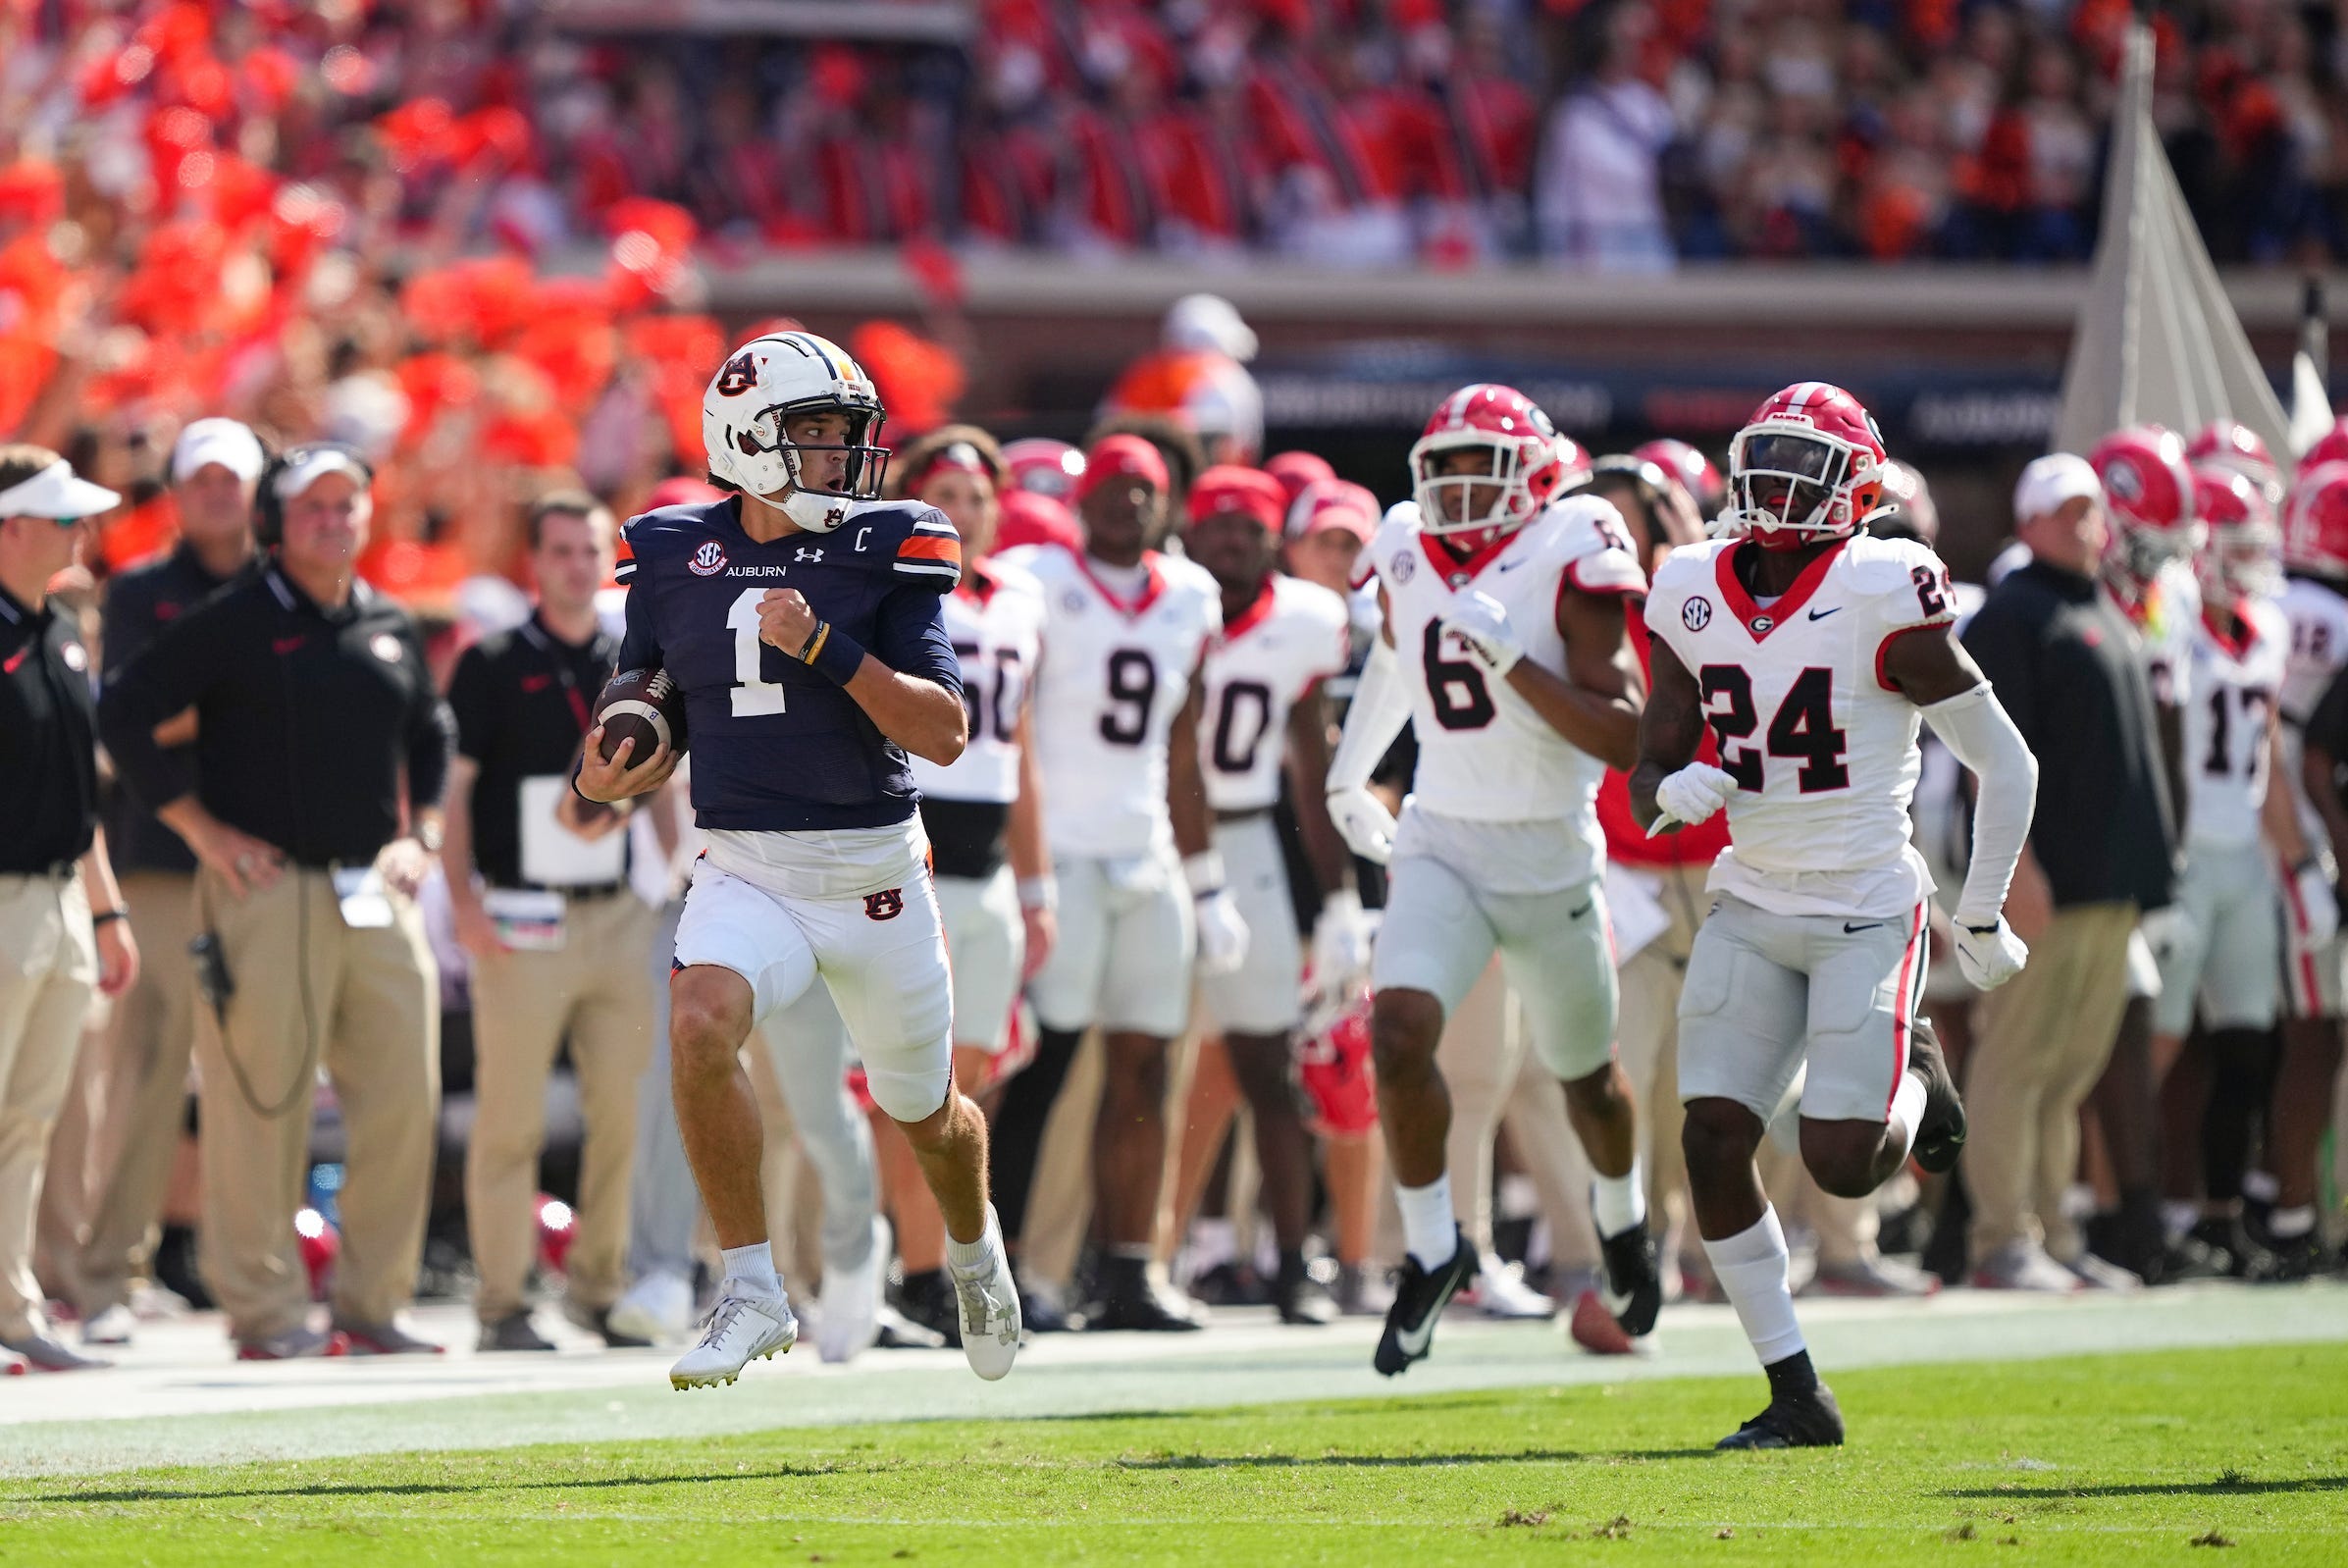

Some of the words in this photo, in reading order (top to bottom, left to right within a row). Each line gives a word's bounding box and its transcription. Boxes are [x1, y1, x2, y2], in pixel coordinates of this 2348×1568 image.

[855, 527, 872, 552] C
[697, 542, 721, 567] SEC
[725, 566, 786, 577] AUBURN
[1684, 600, 1711, 629] SEC
[1753, 617, 1772, 632] G
[725, 587, 786, 717] 1
[1424, 616, 1496, 731] 6
[1100, 649, 1156, 746] 9
[1700, 663, 1850, 796] 24
